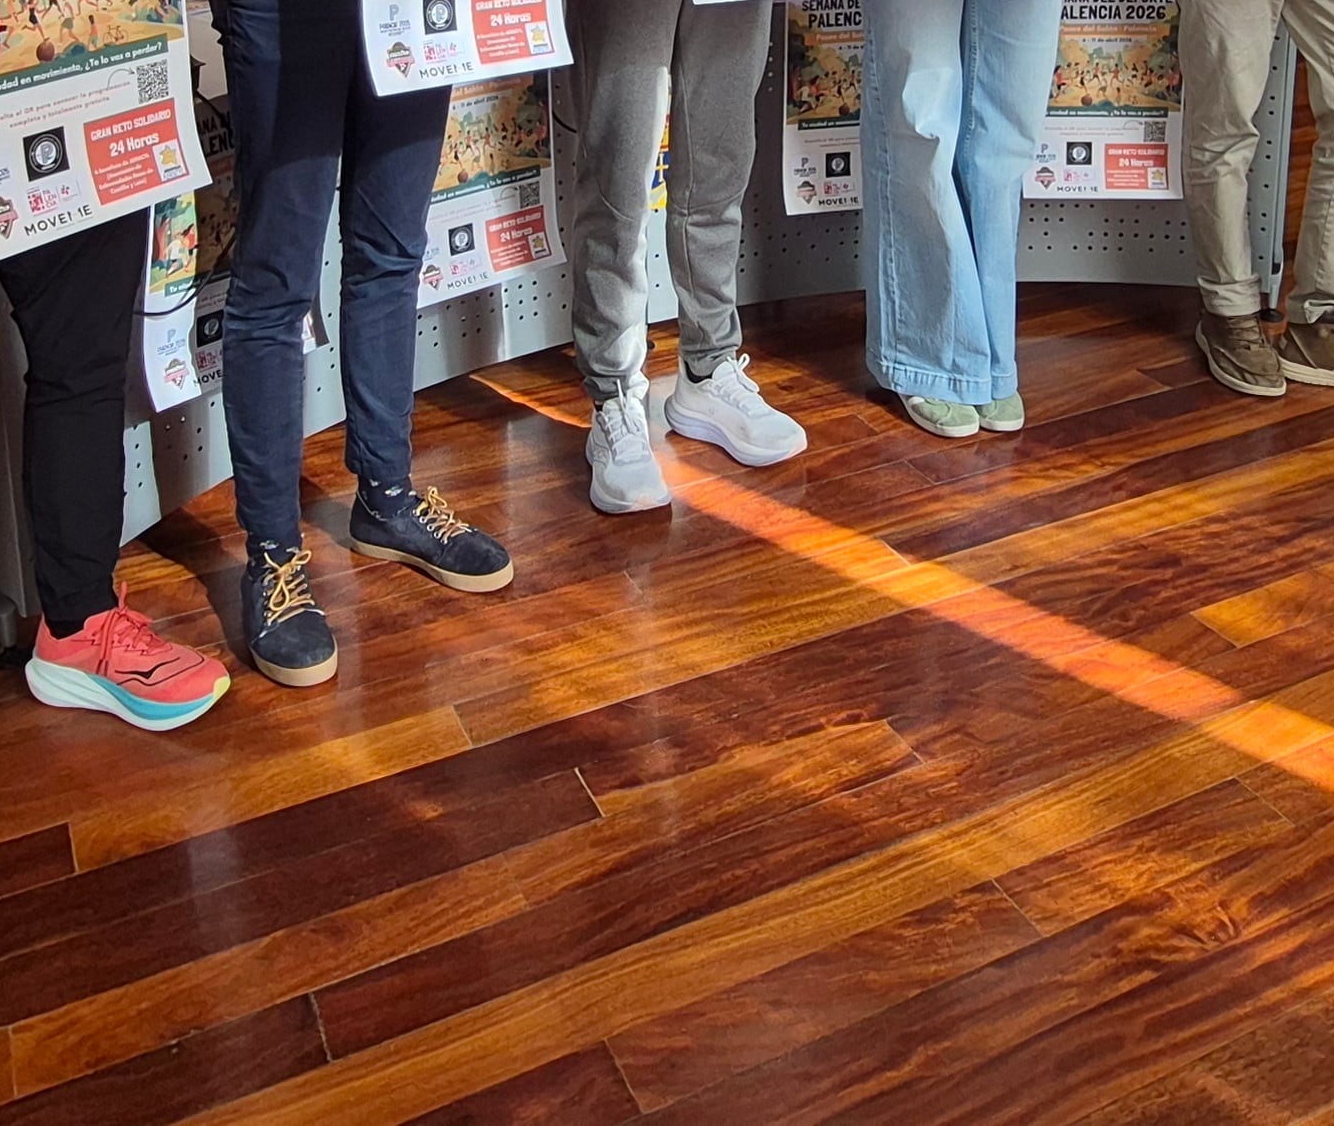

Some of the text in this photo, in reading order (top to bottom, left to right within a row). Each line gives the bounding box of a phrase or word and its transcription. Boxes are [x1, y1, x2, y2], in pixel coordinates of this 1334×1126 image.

[490, 15, 502, 27] 24
[808, 11, 862, 29] PALENC
[1061, 6, 1166, 19] ALENCIA 2026
[34, 64, 83, 81] movimiento,
[85, 59, 99, 70] ¿Te
[101, 55, 108, 64] lo
[111, 53, 123, 61] vas
[133, 42, 162, 58] perder?
[91, 109, 171, 141] GRAN RETO SOLIDARIO
[110, 133, 159, 157] 24 Horas
